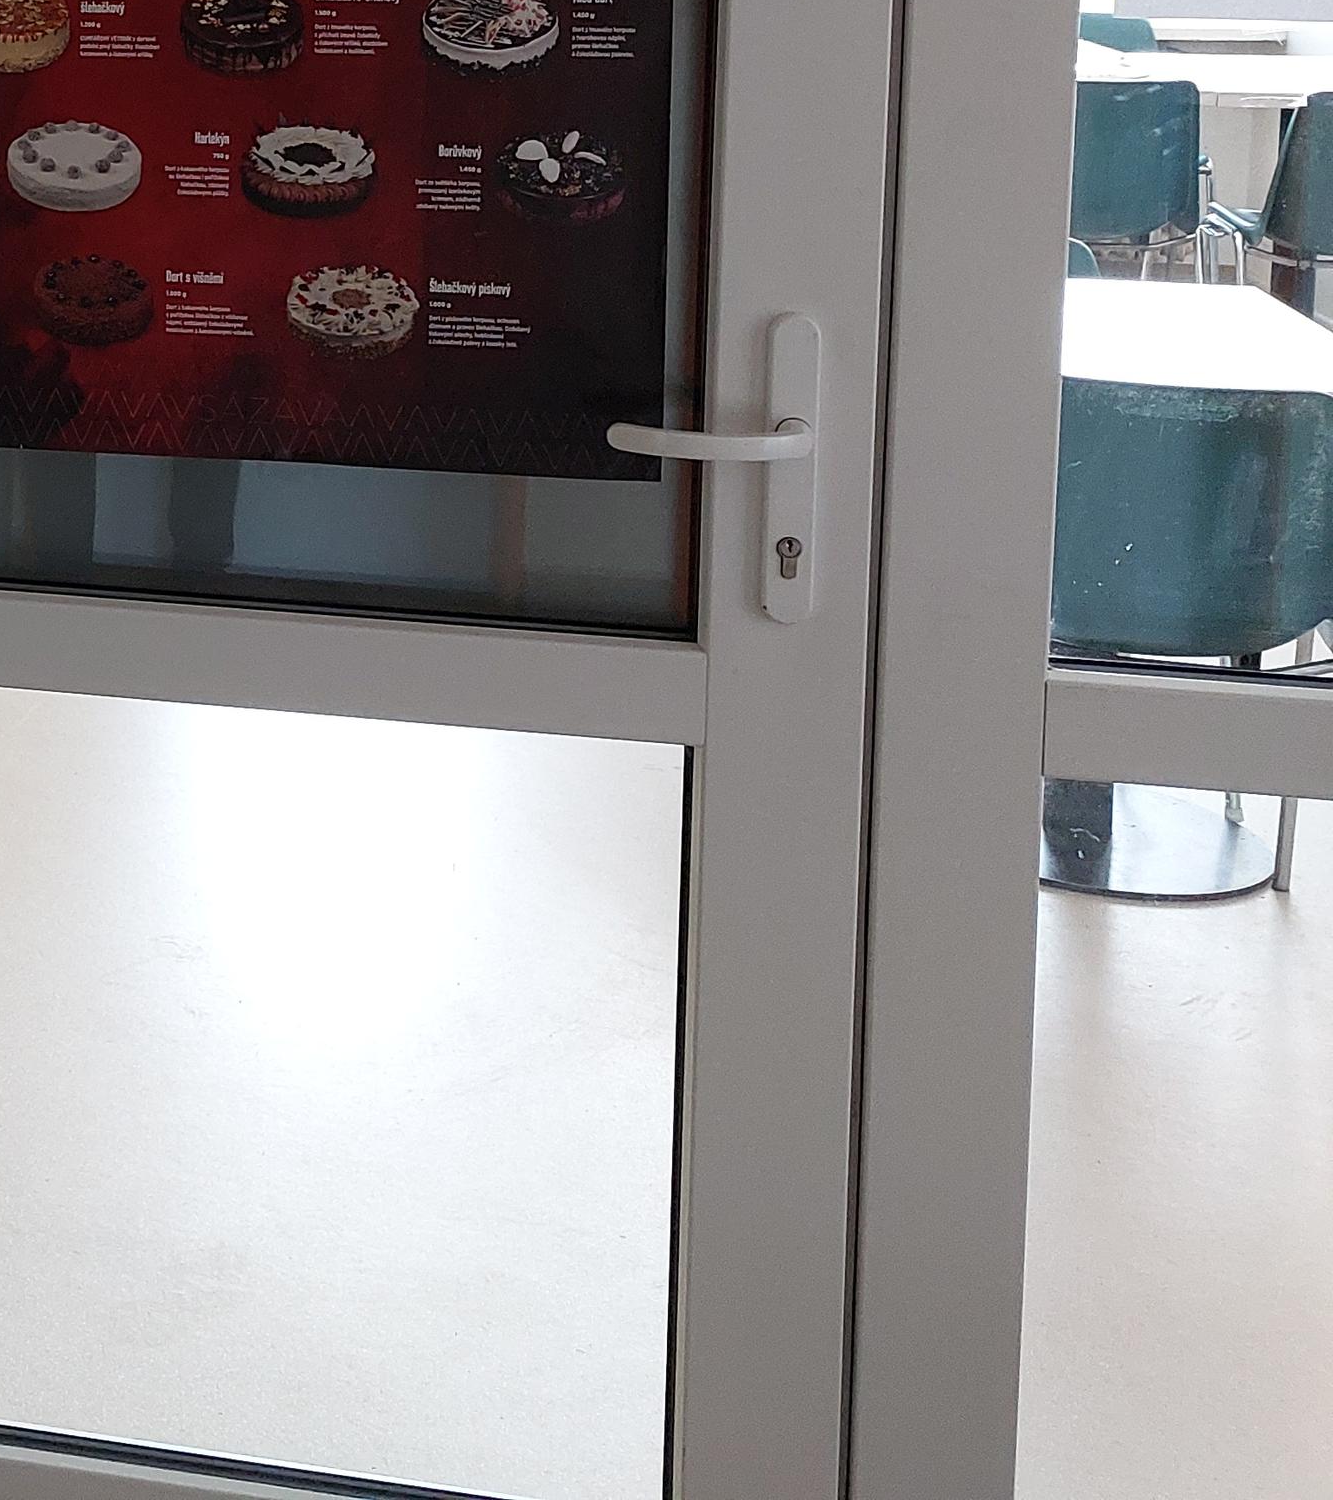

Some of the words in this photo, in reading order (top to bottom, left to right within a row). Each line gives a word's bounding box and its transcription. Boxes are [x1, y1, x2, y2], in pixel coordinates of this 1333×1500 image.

[438, 144, 482, 162] Borůvkový
[165, 269, 184, 284] Dort
[428, 277, 477, 296] Šlehačkový
[477, 278, 512, 299] pískový
